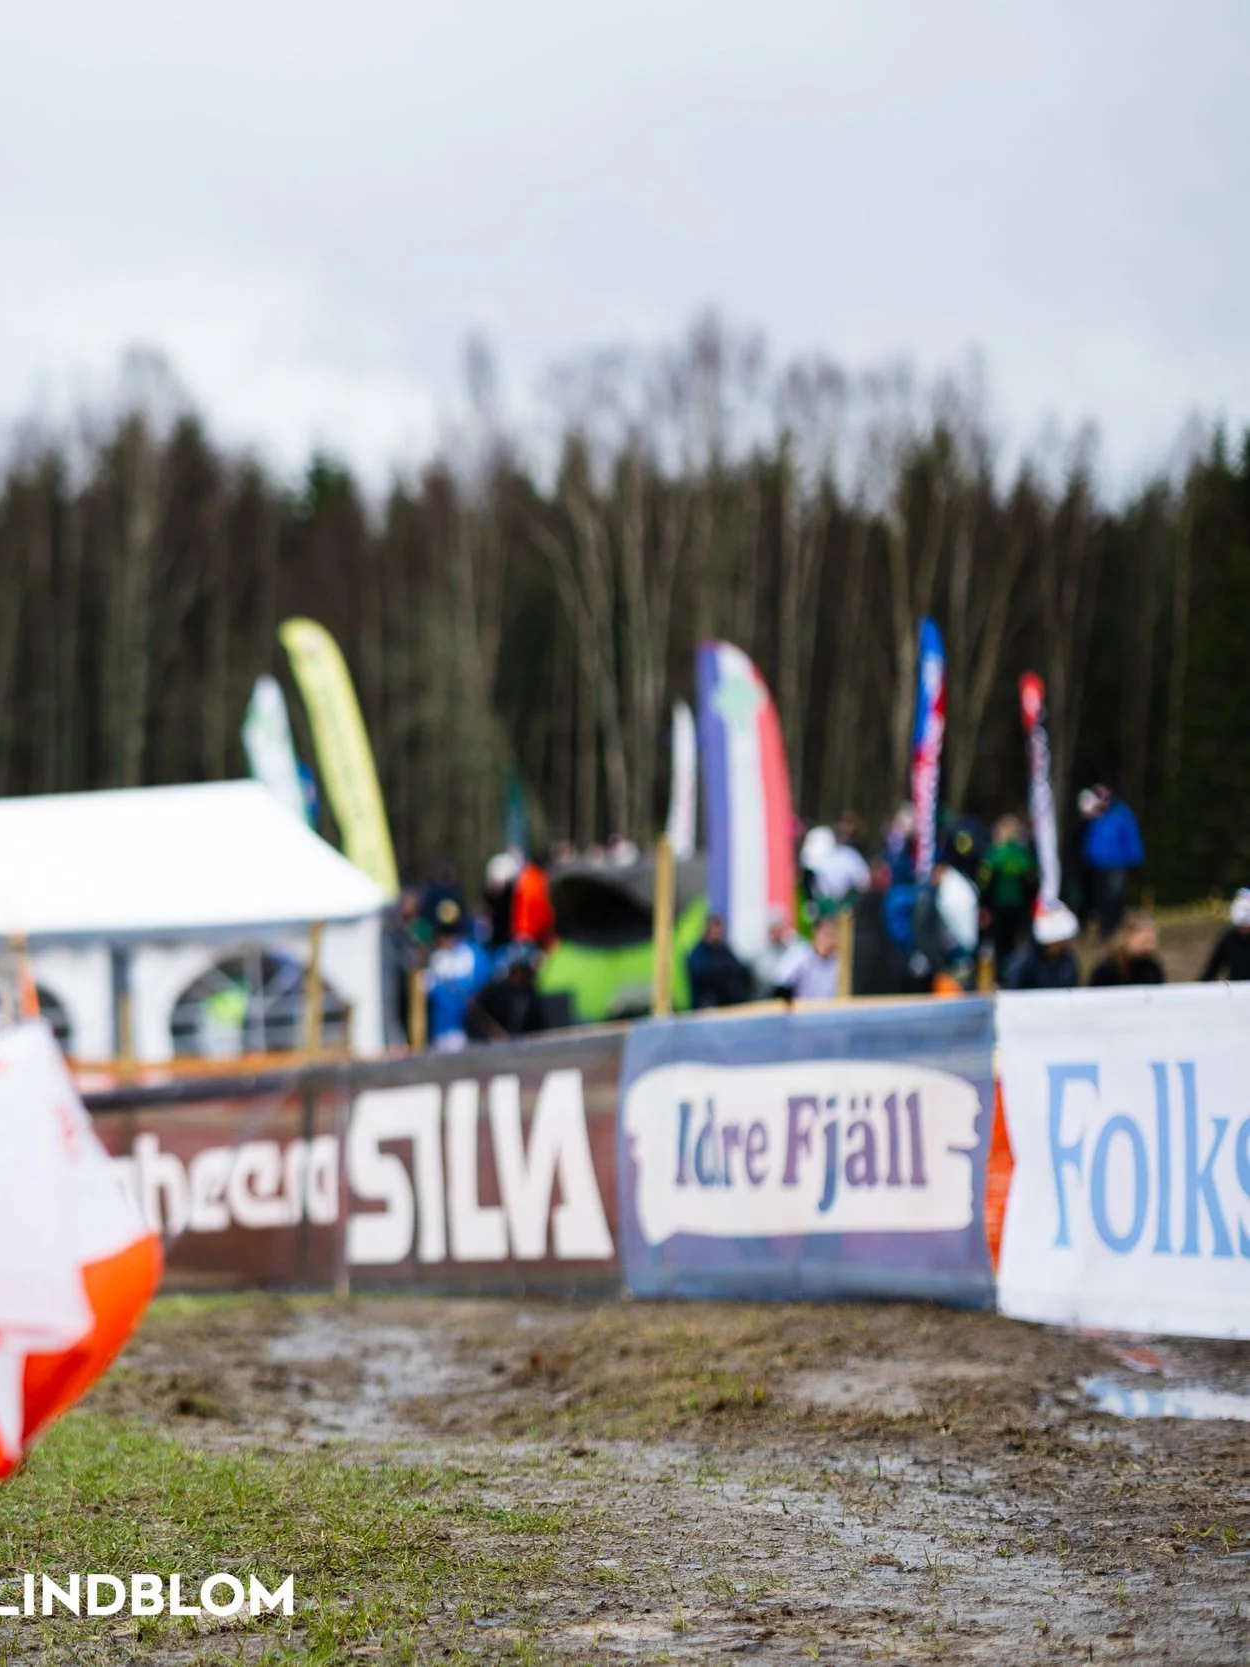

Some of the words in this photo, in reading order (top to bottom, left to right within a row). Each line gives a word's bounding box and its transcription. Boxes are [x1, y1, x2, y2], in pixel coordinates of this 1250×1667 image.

[348, 1068, 615, 1265] SILVA
[675, 1094, 769, 1188] Idre
[781, 1090, 928, 1212] Fjäll
